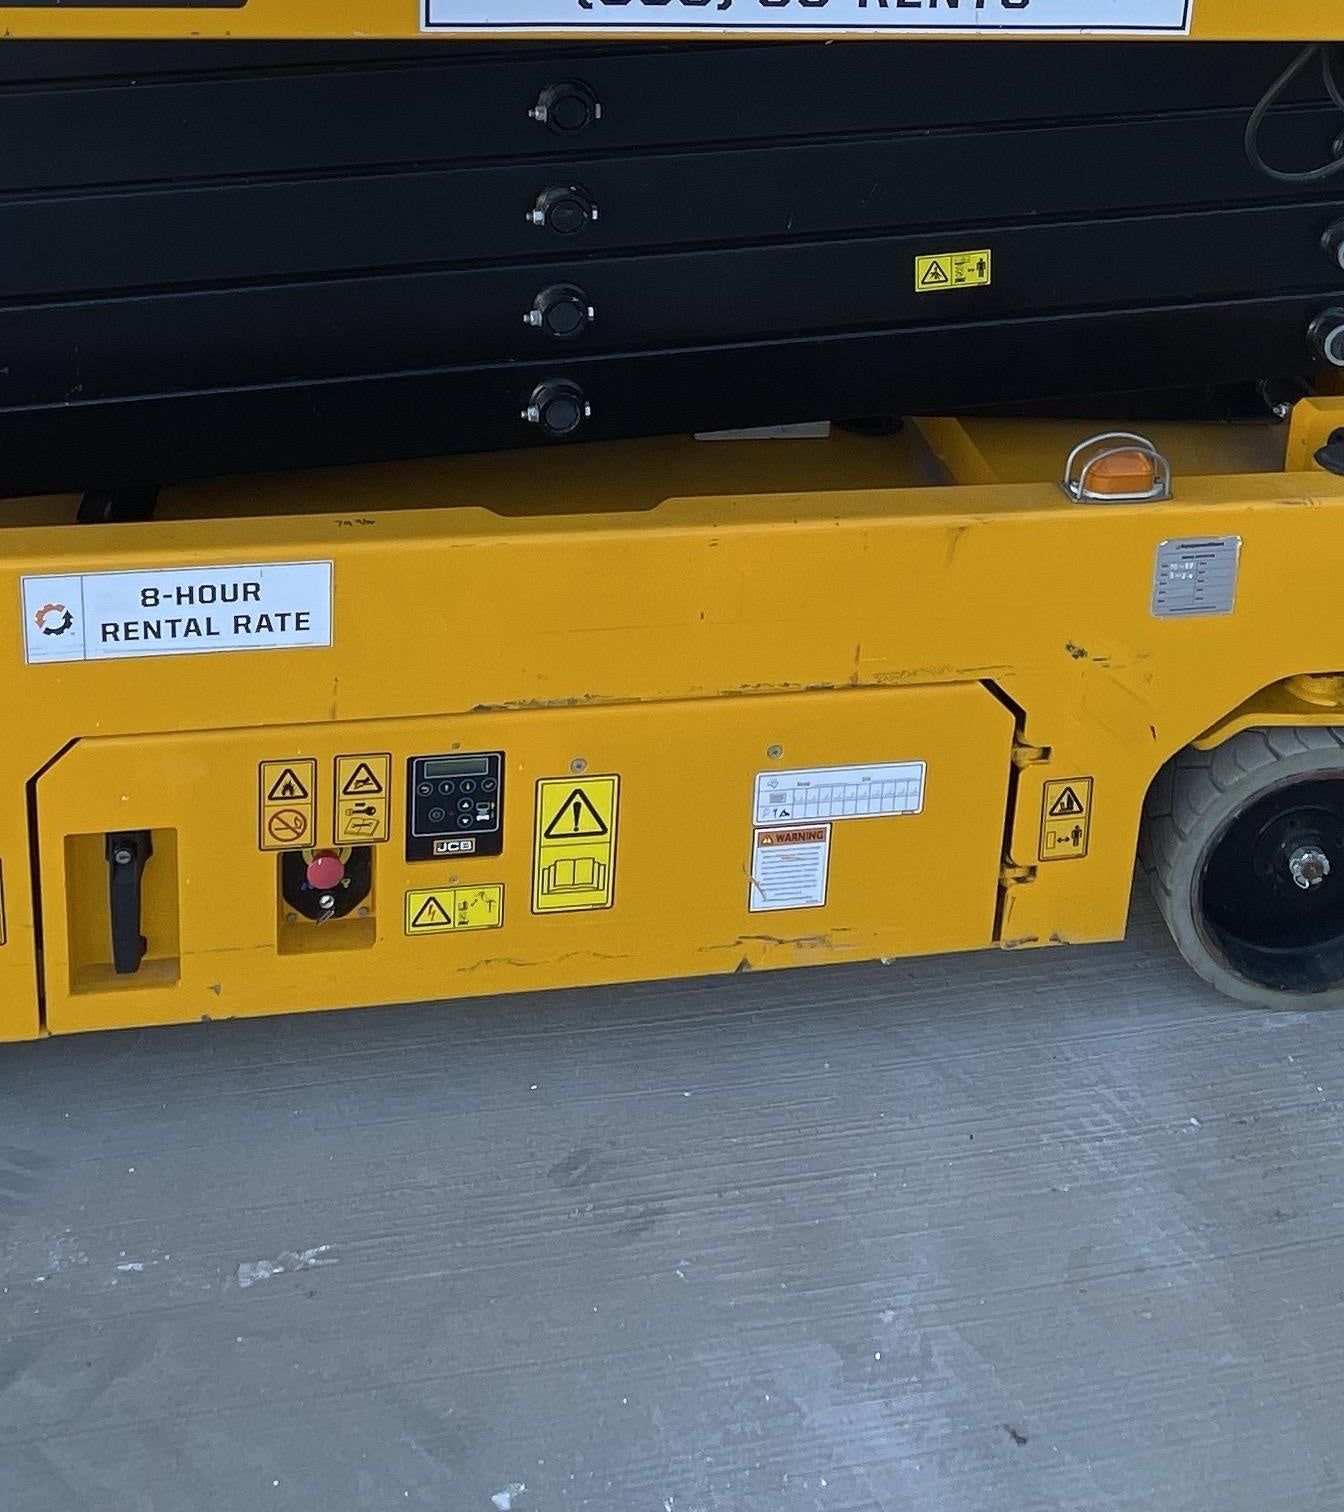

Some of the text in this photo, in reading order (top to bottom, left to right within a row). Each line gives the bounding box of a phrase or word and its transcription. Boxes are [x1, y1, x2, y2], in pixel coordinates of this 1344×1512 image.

[140, 581, 261, 608] 8-HOUR
[100, 610, 311, 643] RENTAL RATE
[436, 840, 473, 853] JCB
[775, 830, 824, 843] WARNING
